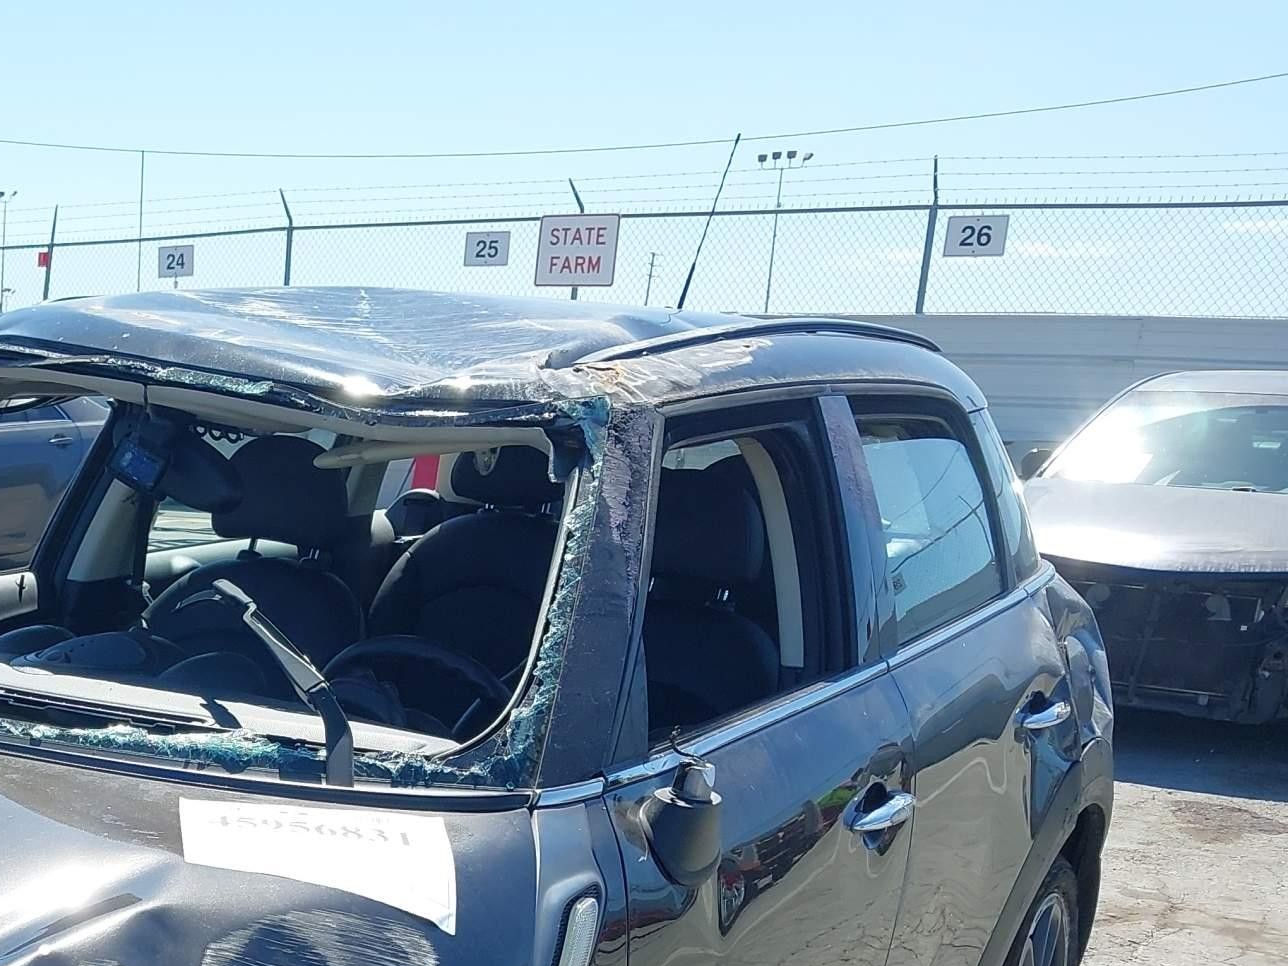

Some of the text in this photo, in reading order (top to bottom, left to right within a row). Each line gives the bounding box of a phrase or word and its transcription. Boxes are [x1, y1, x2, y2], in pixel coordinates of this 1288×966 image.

[550, 227, 607, 245] STATE
[958, 224, 993, 247] 26
[475, 240, 499, 258] 25
[166, 252, 186, 270] 24
[549, 256, 601, 274] FARM
